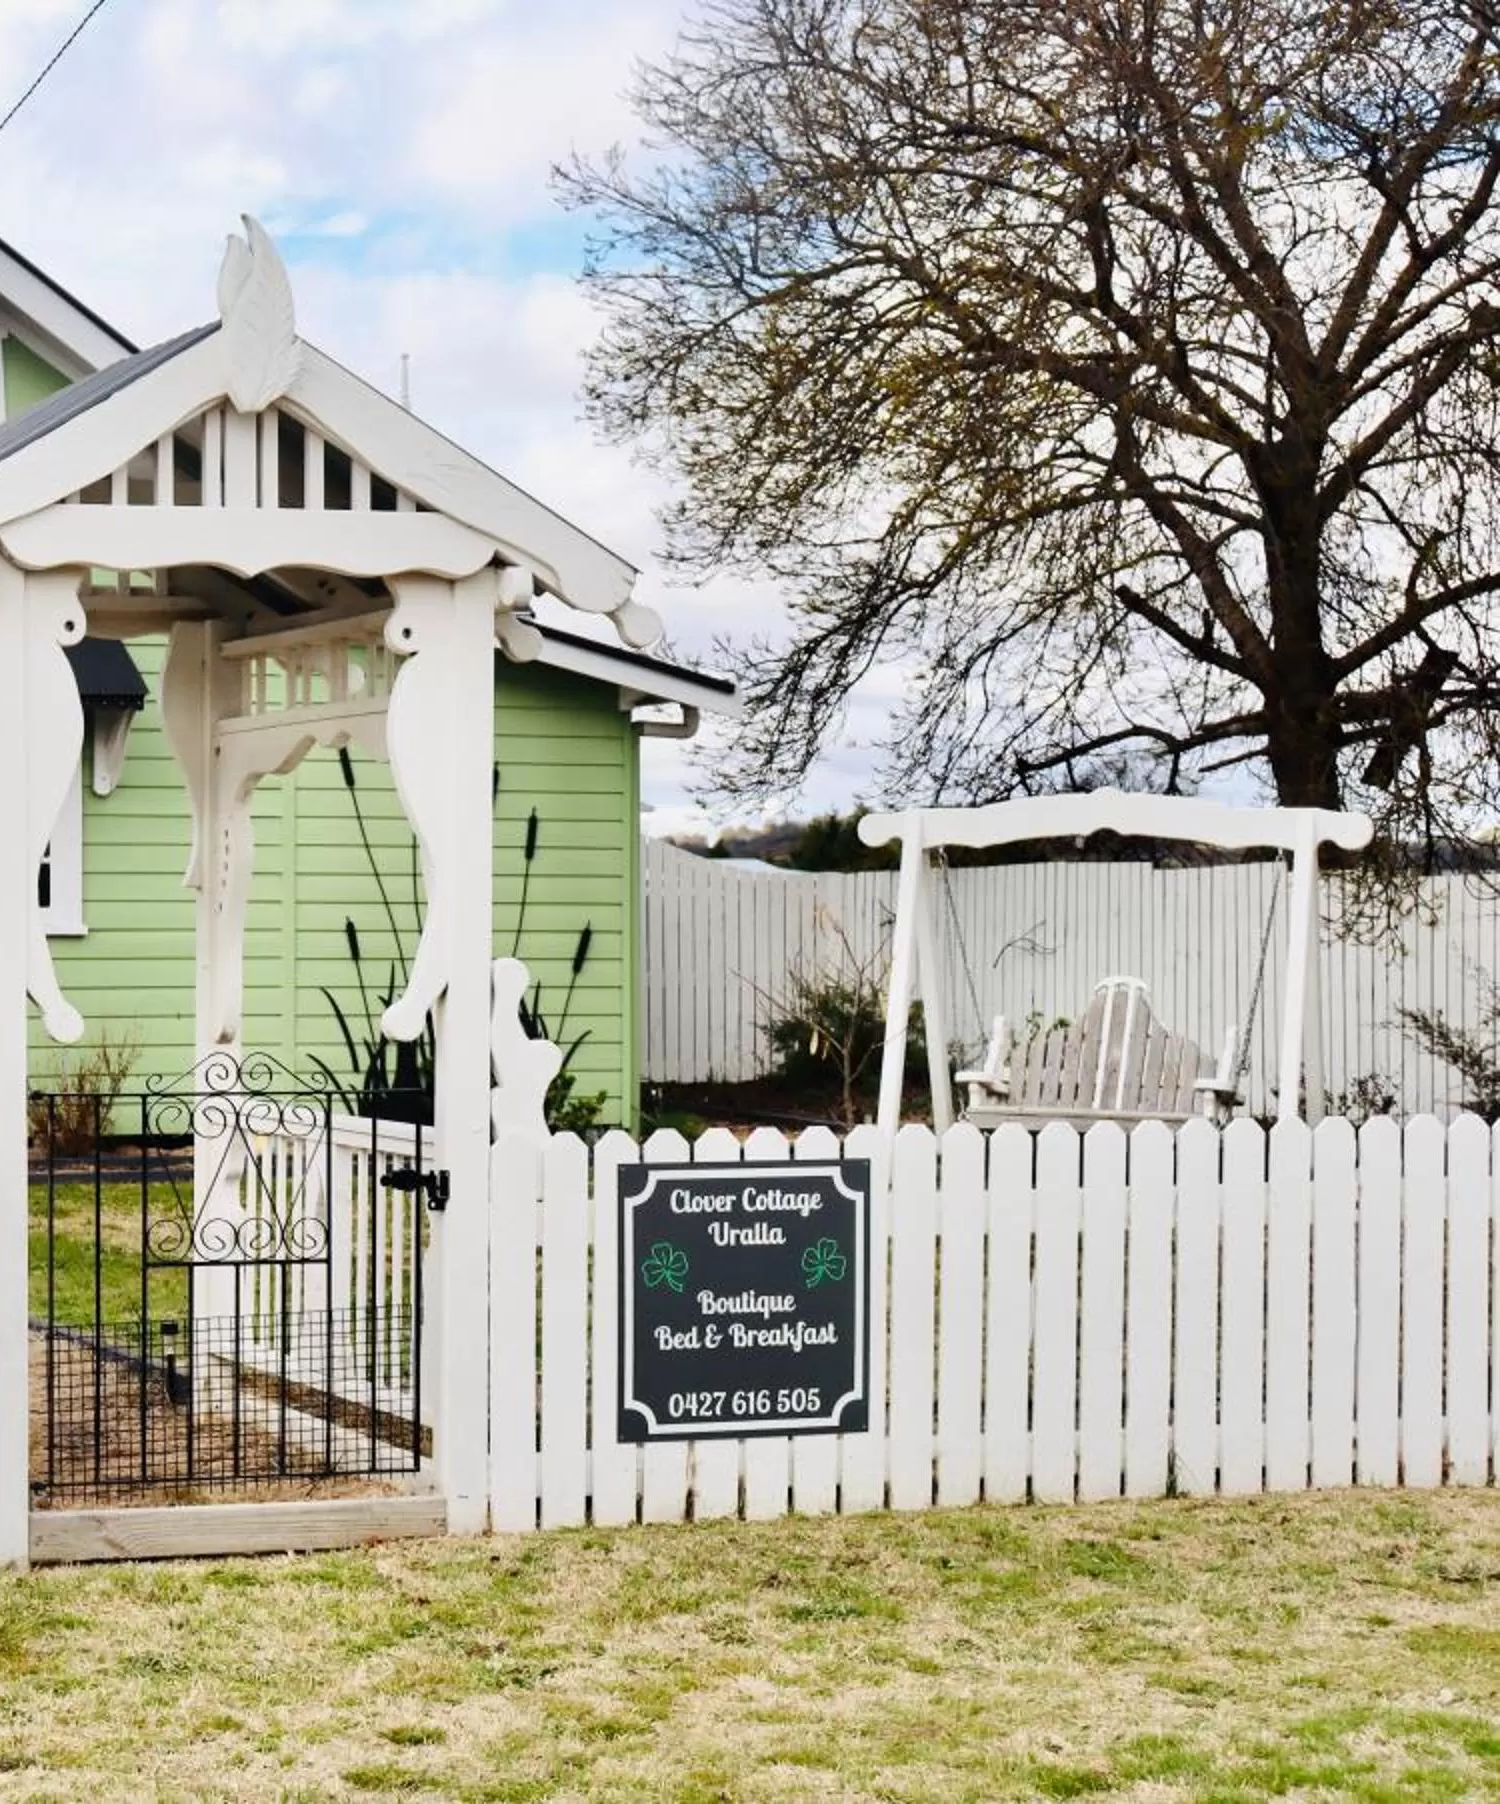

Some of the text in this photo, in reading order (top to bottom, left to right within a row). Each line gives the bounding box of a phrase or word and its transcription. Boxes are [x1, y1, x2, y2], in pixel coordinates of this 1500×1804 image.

[670, 1187, 823, 1217] Clover Cottage
[708, 1221, 786, 1246] Uralla
[697, 1289, 796, 1320] Boutique
[654, 1321, 838, 1352] Bed & Breakfast
[668, 1388, 821, 1418] 0427 616 505
